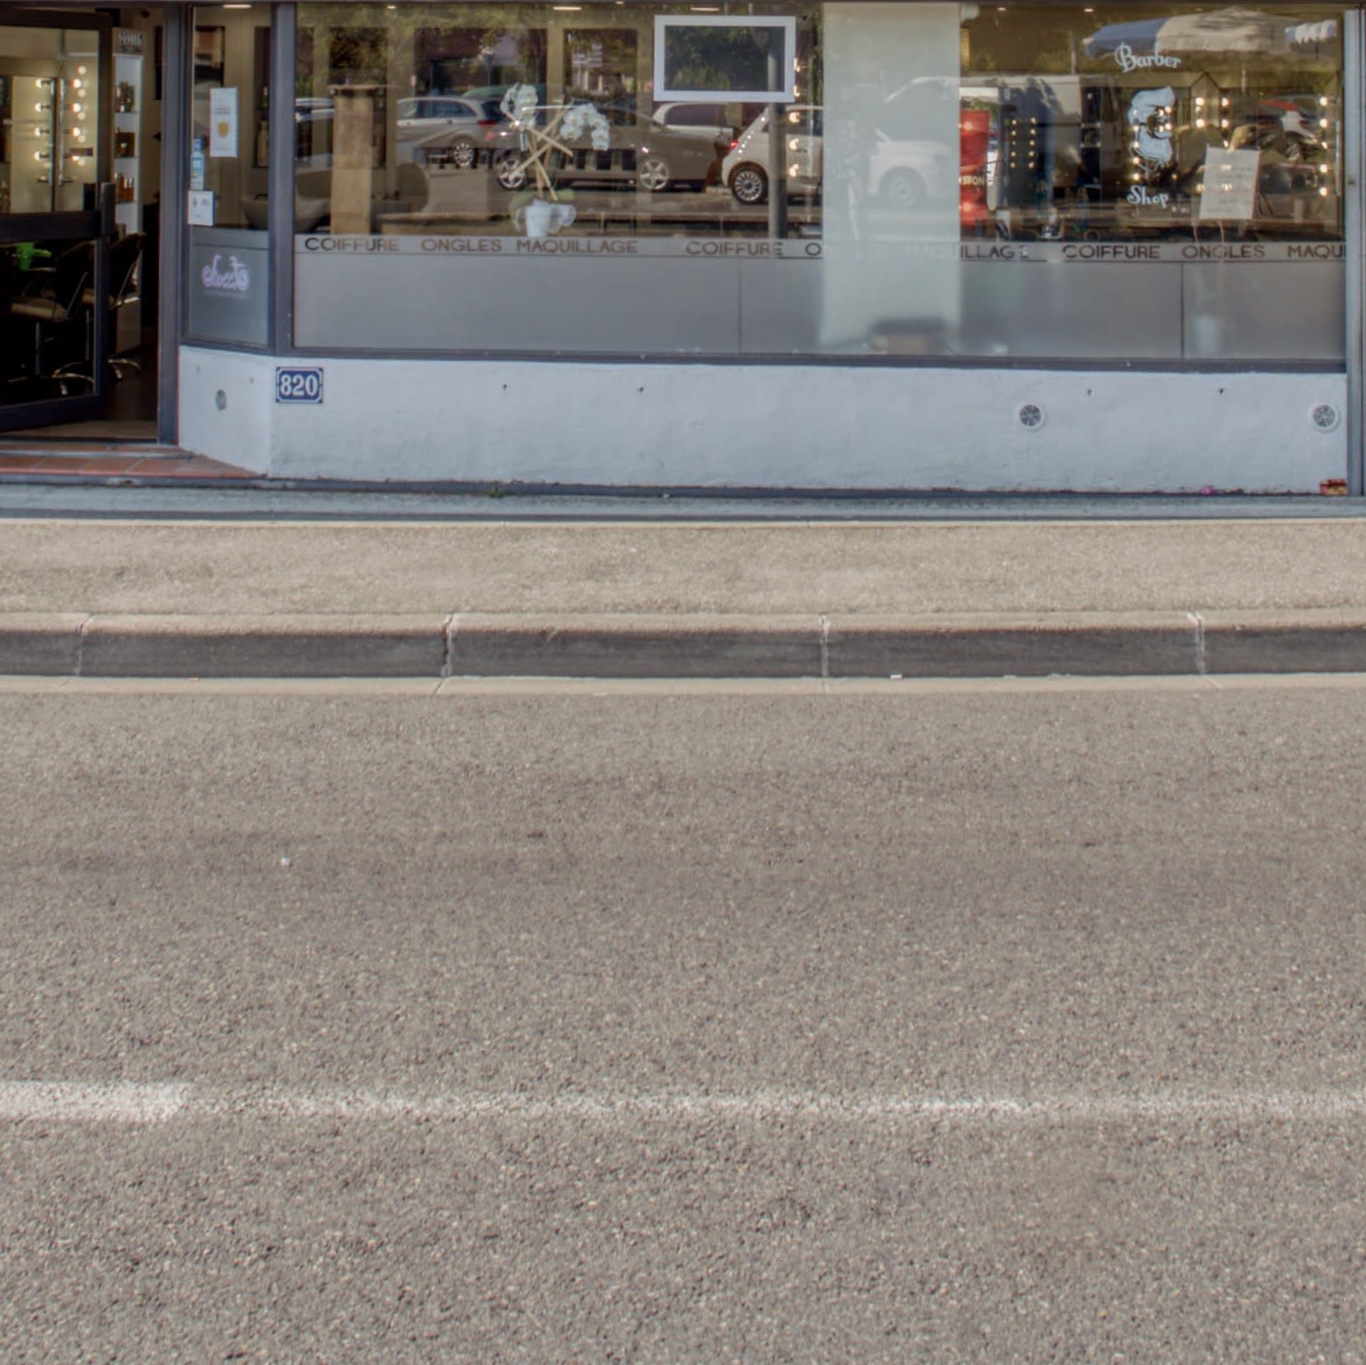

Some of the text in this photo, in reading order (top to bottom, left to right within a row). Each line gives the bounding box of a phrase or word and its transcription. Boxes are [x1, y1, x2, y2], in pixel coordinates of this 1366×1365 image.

[1114, 41, 1182, 73] Barber
[1126, 185, 1170, 208] Shop
[305, 237, 783, 257] COIFFURE ONGLES MAQUILLAGE COIFFURE
[1061, 244, 1161, 259] COIFFURE
[1182, 244, 1266, 260] ONGLES
[280, 374, 319, 397] 820
